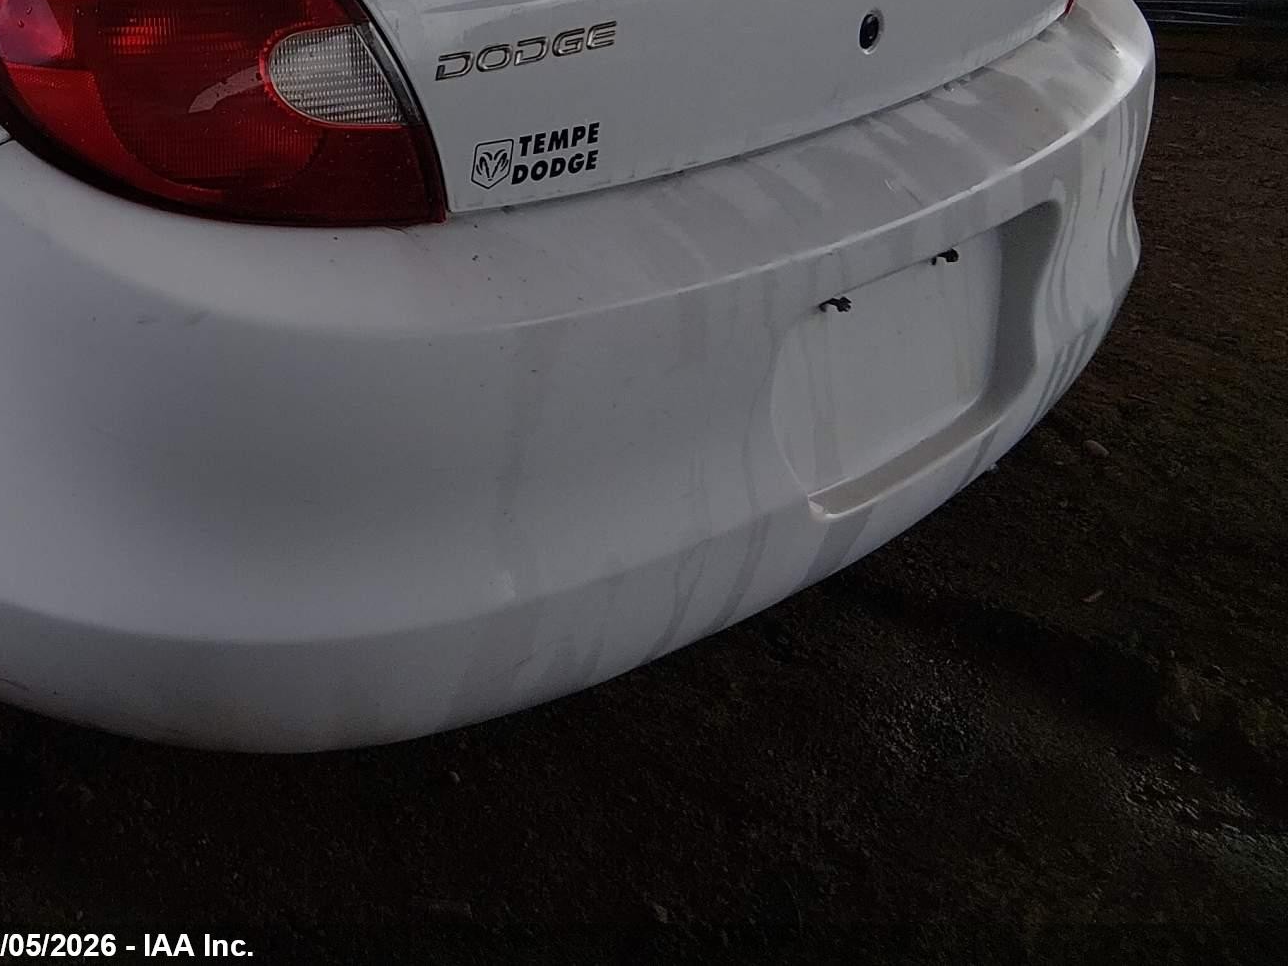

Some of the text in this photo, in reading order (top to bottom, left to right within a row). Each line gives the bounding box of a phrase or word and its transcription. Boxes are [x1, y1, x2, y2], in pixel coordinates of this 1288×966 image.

[435, 21, 617, 81] DODGE
[519, 122, 600, 157] TEMPE
[511, 150, 599, 185] DODGE
